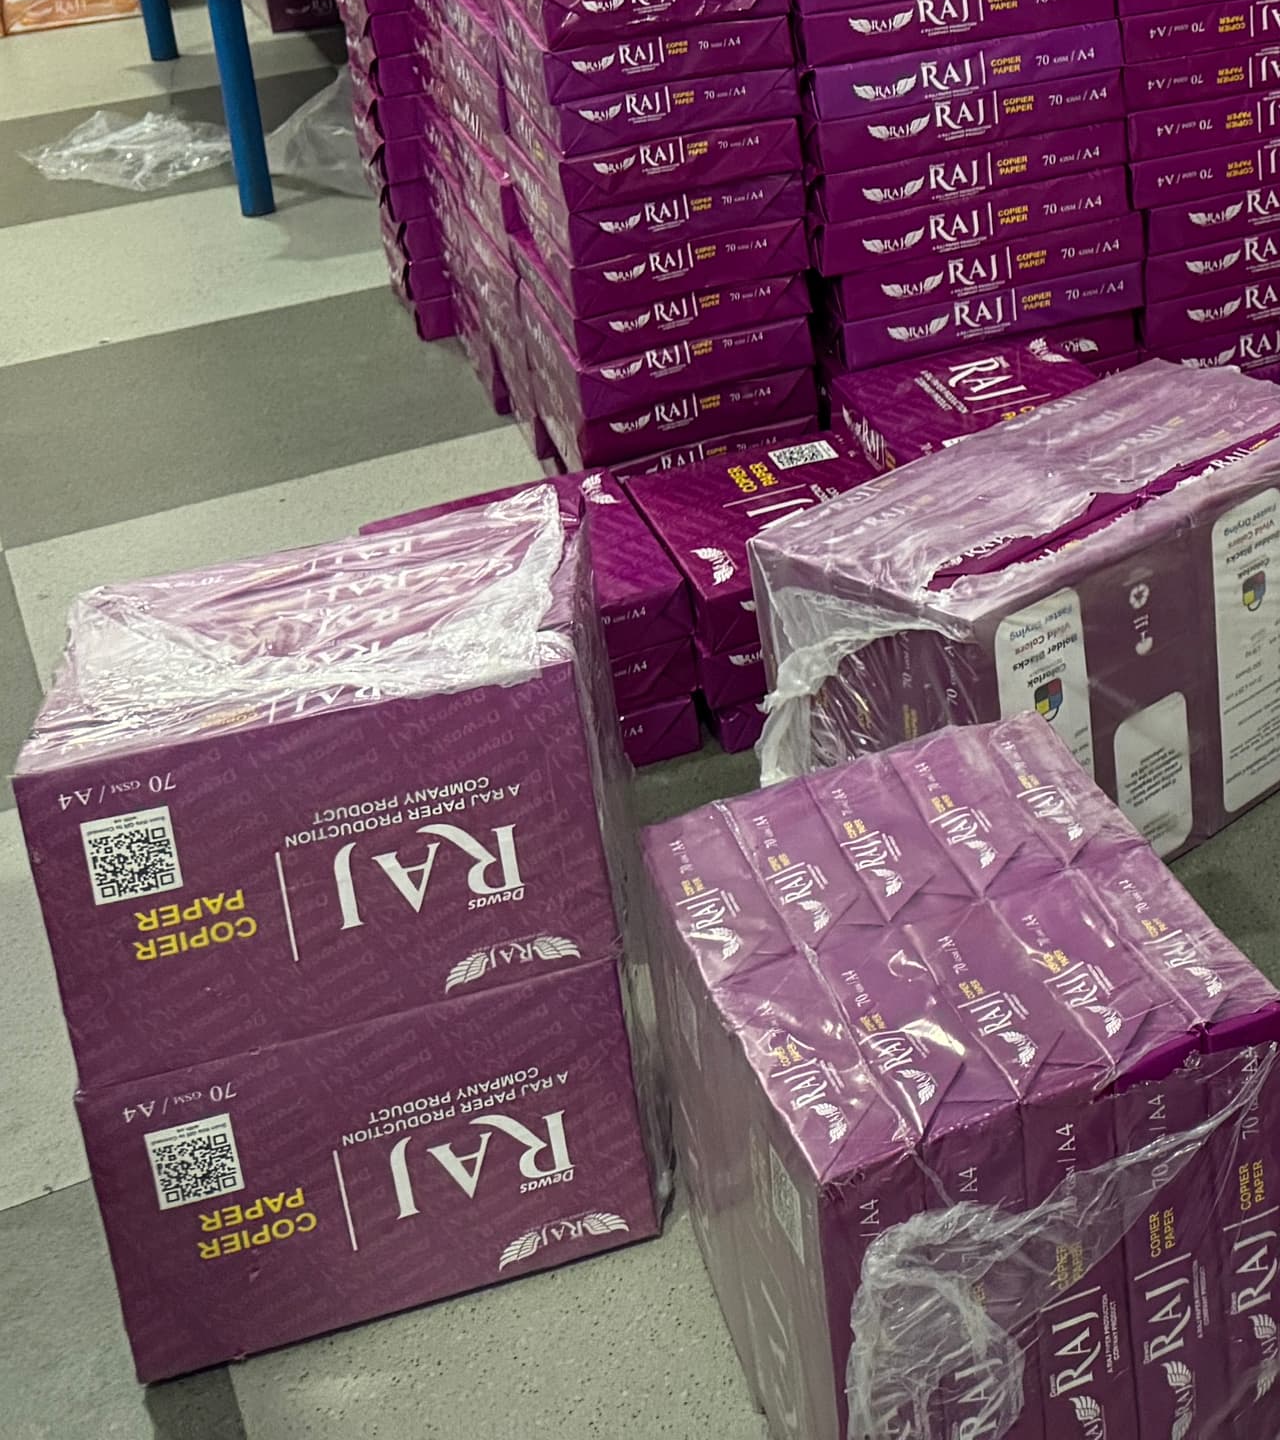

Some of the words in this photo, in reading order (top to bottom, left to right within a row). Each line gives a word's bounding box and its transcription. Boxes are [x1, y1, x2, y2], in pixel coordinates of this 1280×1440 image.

[920, 57, 972, 89] RAJ
[110, 780, 141, 794] GSM
[149, 772, 176, 793] 70
[403, 777, 489, 805] COMPANY
[509, 784, 521, 796] A
[57, 789, 94, 809] A4
[312, 796, 399, 825] PRODUCT
[408, 800, 465, 819] PAPER
[472, 789, 504, 806] RAJ
[285, 813, 403, 848] PRODUCTION
[333, 823, 526, 930] RAJ
[134, 889, 245, 932] PAPER
[468, 887, 526, 910] Dewas
[132, 915, 258, 961] COPIER
[490, 943, 534, 968] RAJ
[458, 1067, 539, 1100] COMPANY
[522, 1078, 553, 1096] RAJ
[556, 1071, 569, 1085] A
[209, 1080, 237, 1103] 70
[461, 1090, 516, 1113] PAPER
[122, 1101, 156, 1123] A4
[368, 1092, 451, 1124] PRODUCT
[342, 1107, 455, 1147] PRODUCTION
[390, 1110, 576, 1220] RAJ
[520, 1169, 574, 1193] Dewas
[199, 1187, 305, 1232] PAPER
[198, 1213, 318, 1261] COPIER
[1236, 1221, 1280, 1314] RAJ
